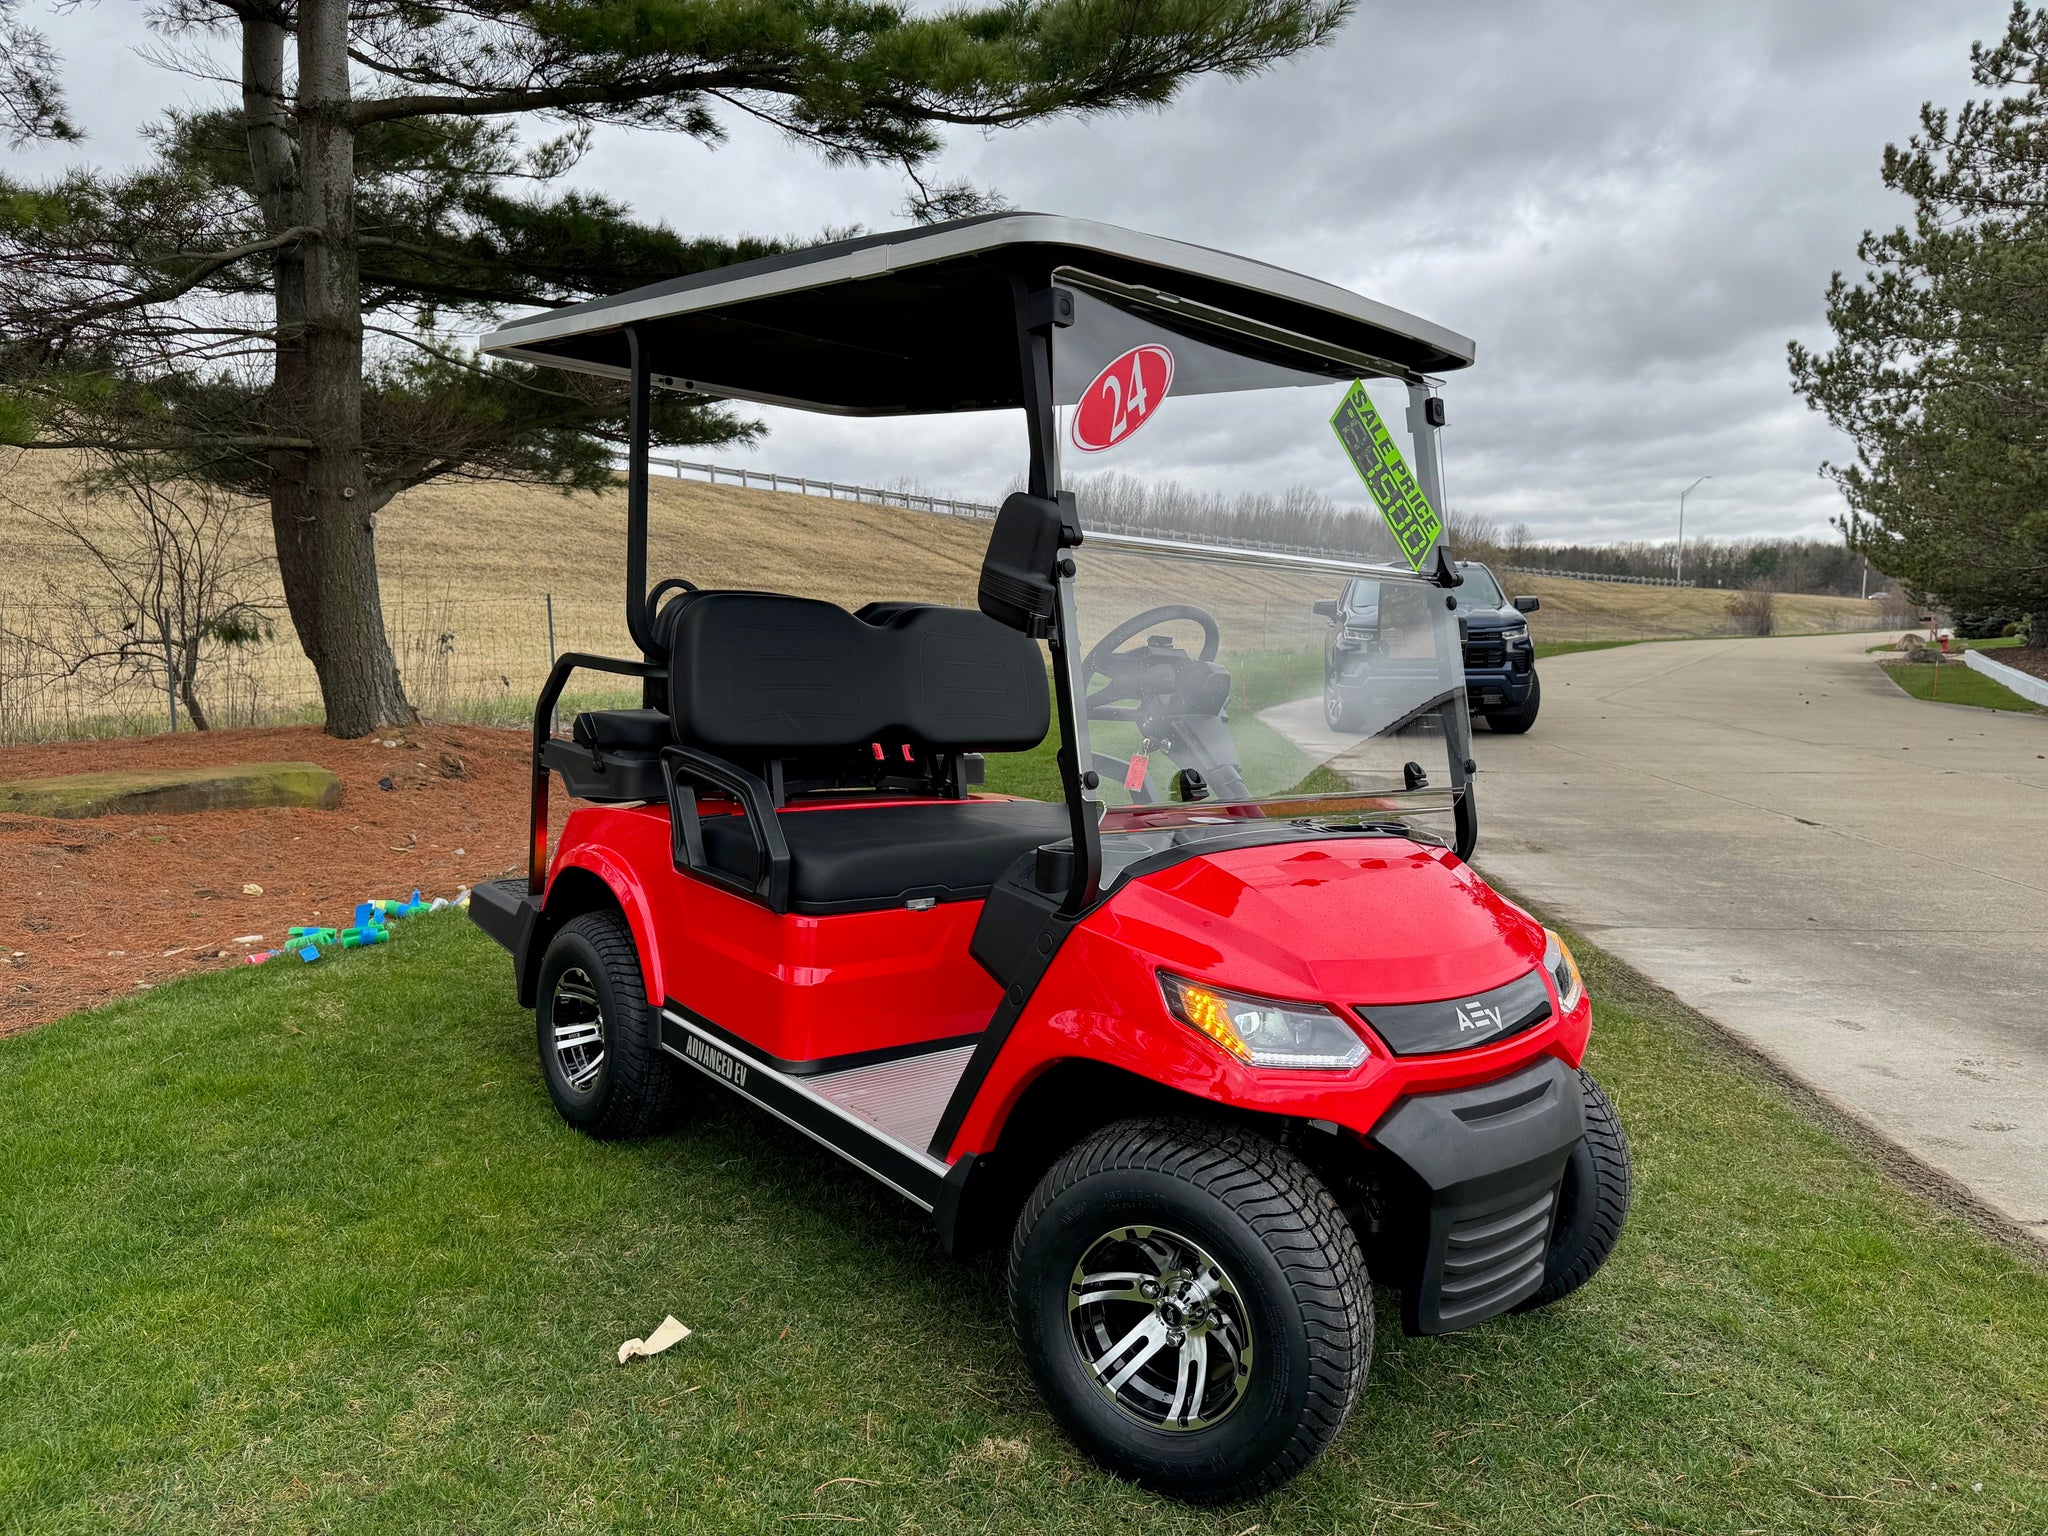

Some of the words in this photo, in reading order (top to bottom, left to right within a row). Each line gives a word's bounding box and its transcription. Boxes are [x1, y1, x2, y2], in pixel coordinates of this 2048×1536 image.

[1102, 351, 1148, 443] 24
[1351, 389, 1395, 458] SALE
[1390, 460, 1439, 535] PRICE
[1455, 1001, 1504, 1032] AEV
[685, 1034, 734, 1079] ADVANCED
[734, 1061, 748, 1087] EV
